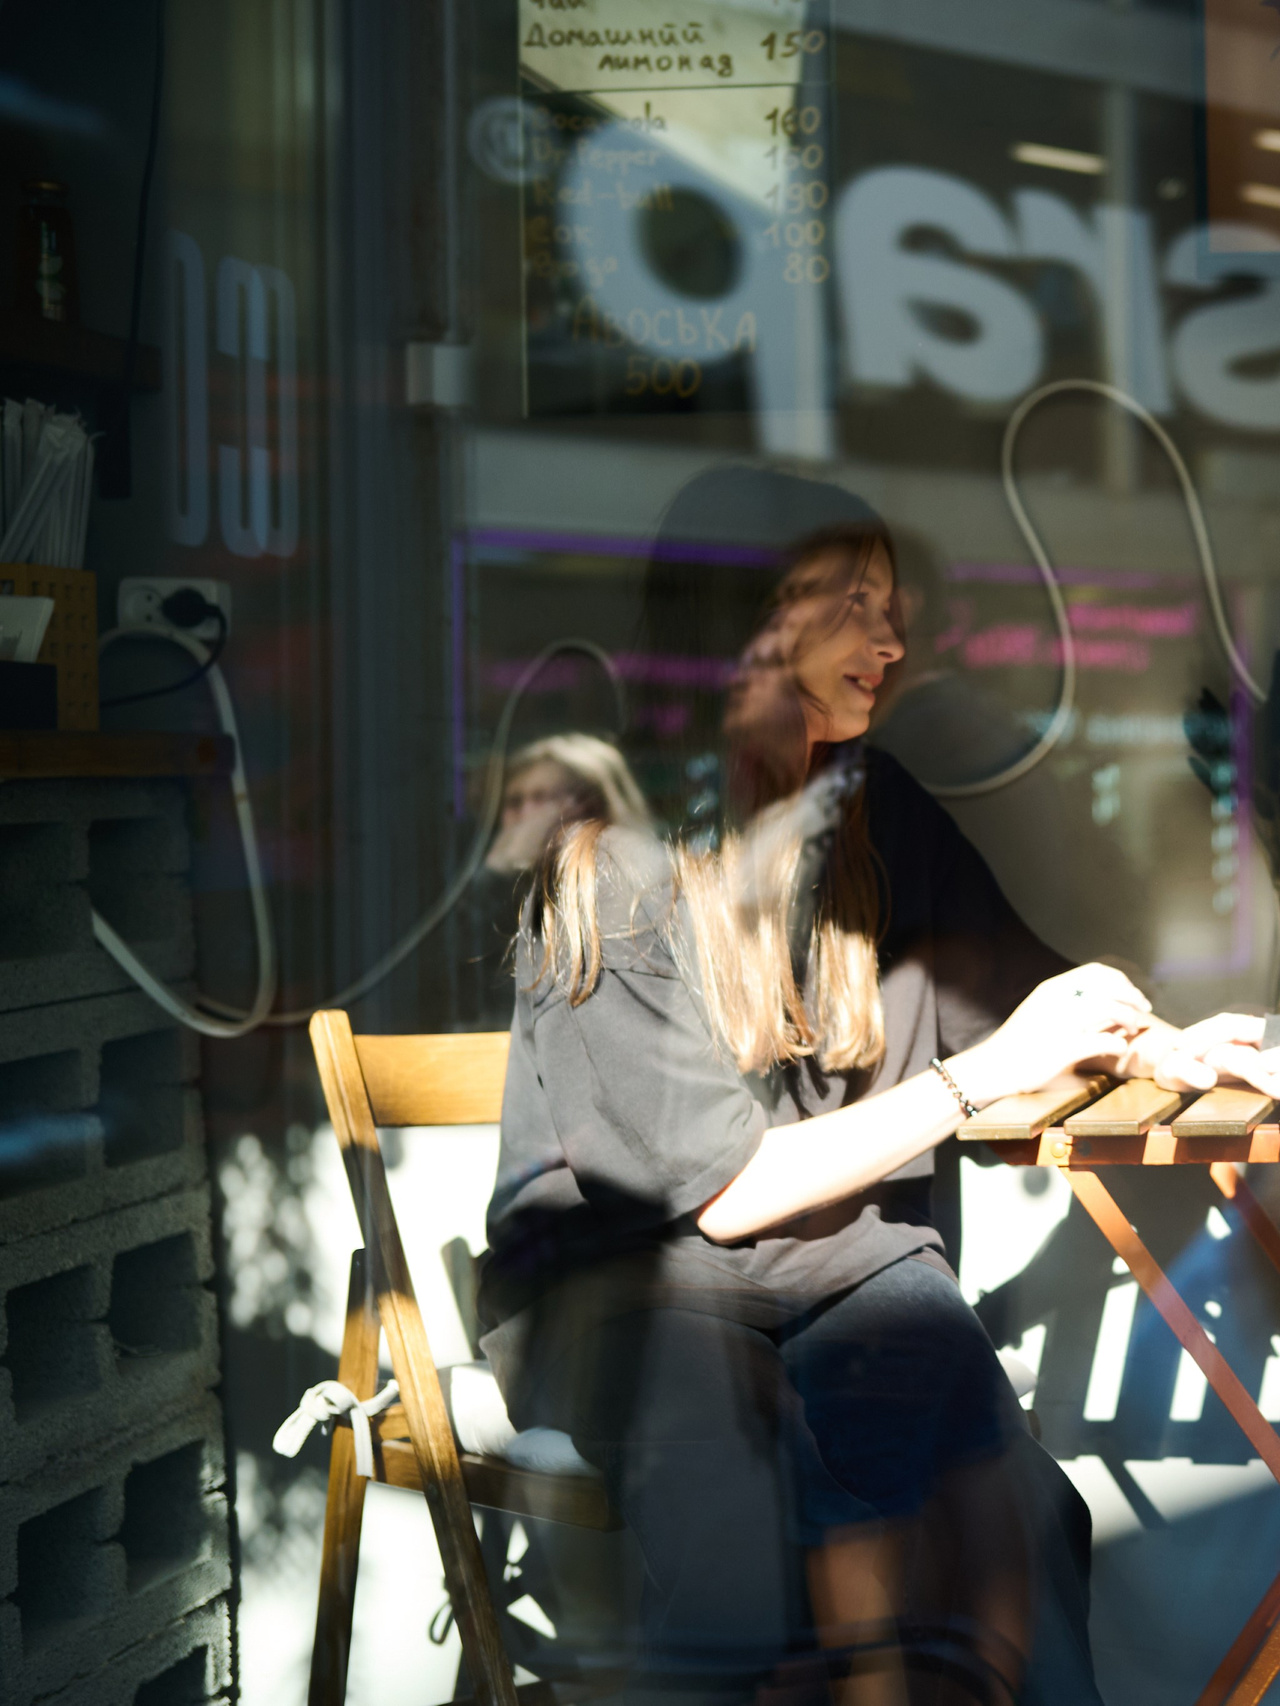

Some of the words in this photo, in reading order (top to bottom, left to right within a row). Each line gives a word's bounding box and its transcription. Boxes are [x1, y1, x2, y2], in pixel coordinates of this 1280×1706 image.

[760, 30, 827, 61] 150
[598, 53, 734, 77] лимонад
[764, 106, 822, 136] 160
[763, 219, 826, 248] 100
[782, 251, 831, 284] 80
[625, 357, 699, 398] 500
